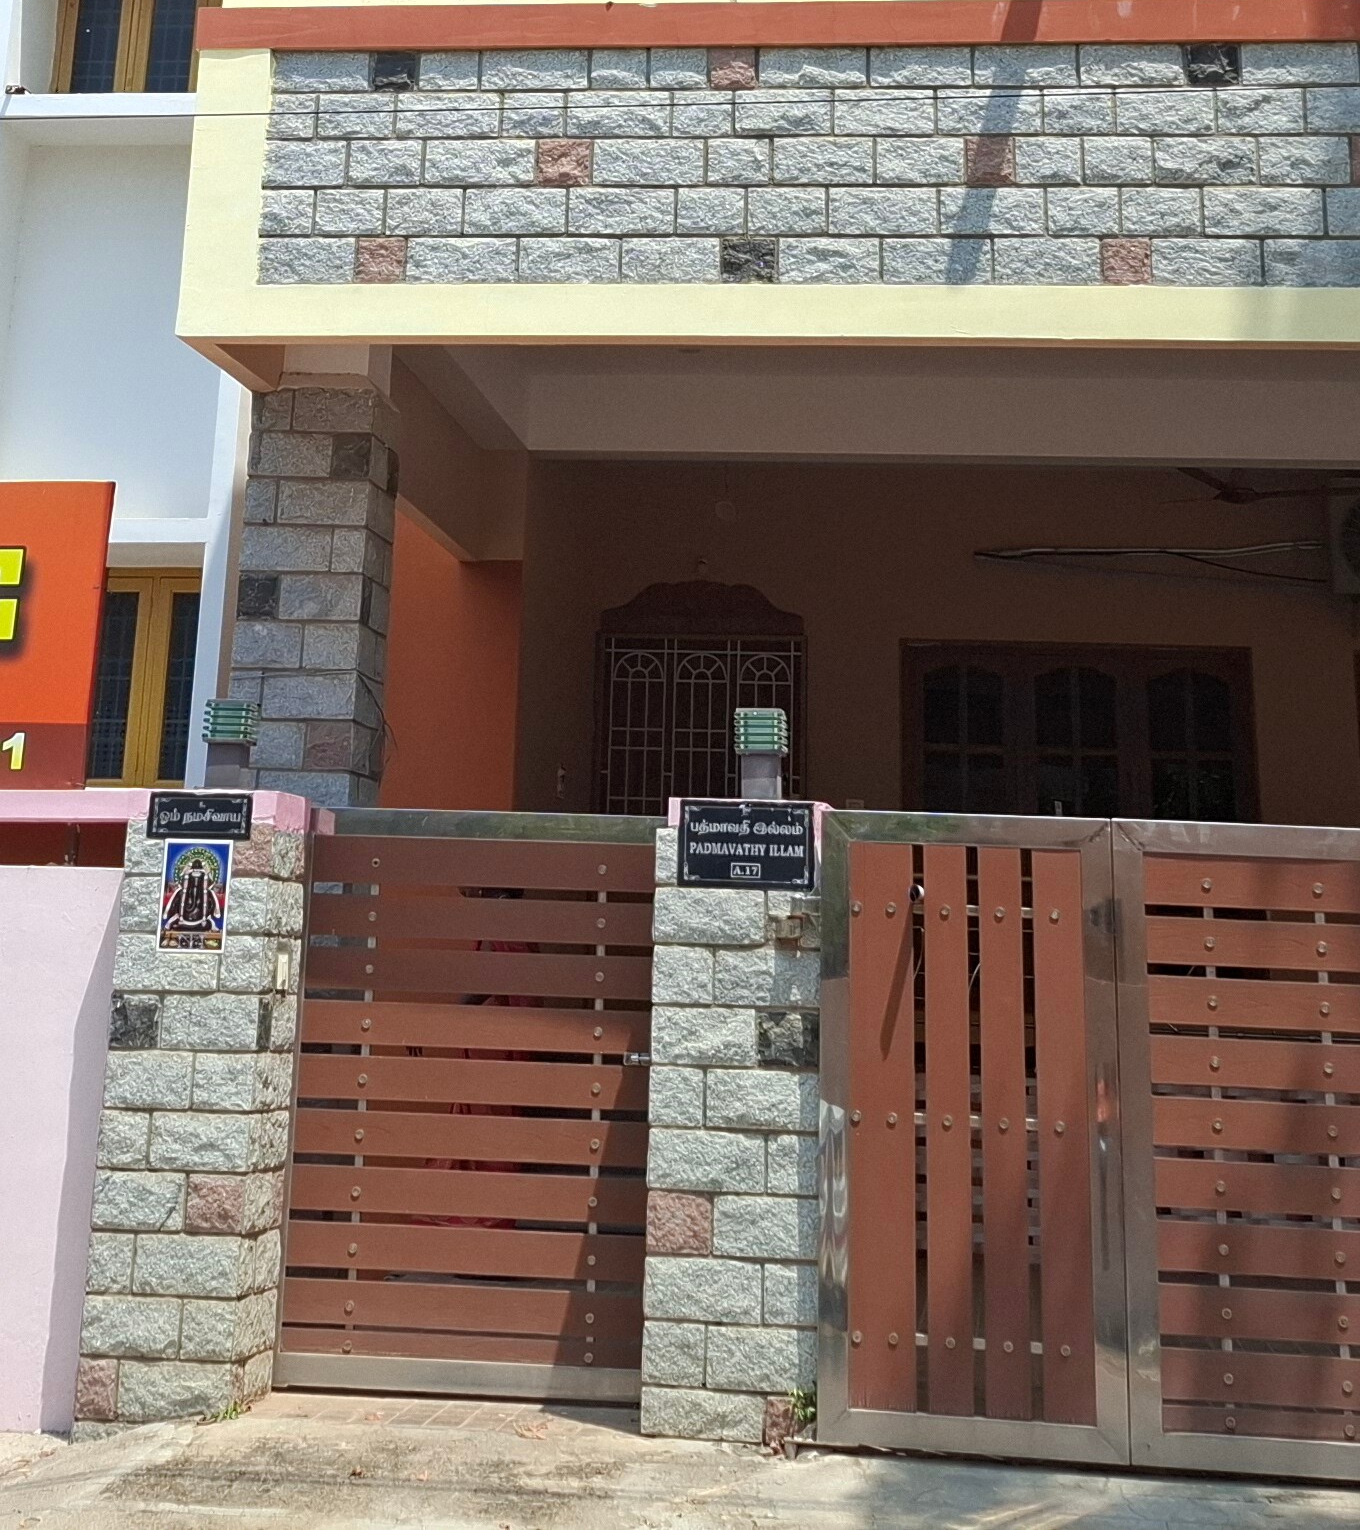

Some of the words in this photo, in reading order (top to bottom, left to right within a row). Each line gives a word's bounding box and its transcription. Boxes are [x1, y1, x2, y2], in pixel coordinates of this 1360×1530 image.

[690, 818, 751, 836] பத்மாவதி
[752, 820, 804, 835] இல்லம்
[689, 841, 767, 857] PADMAVATHY
[769, 844, 805, 858] ILLAM
[732, 865, 758, 876] A.17
